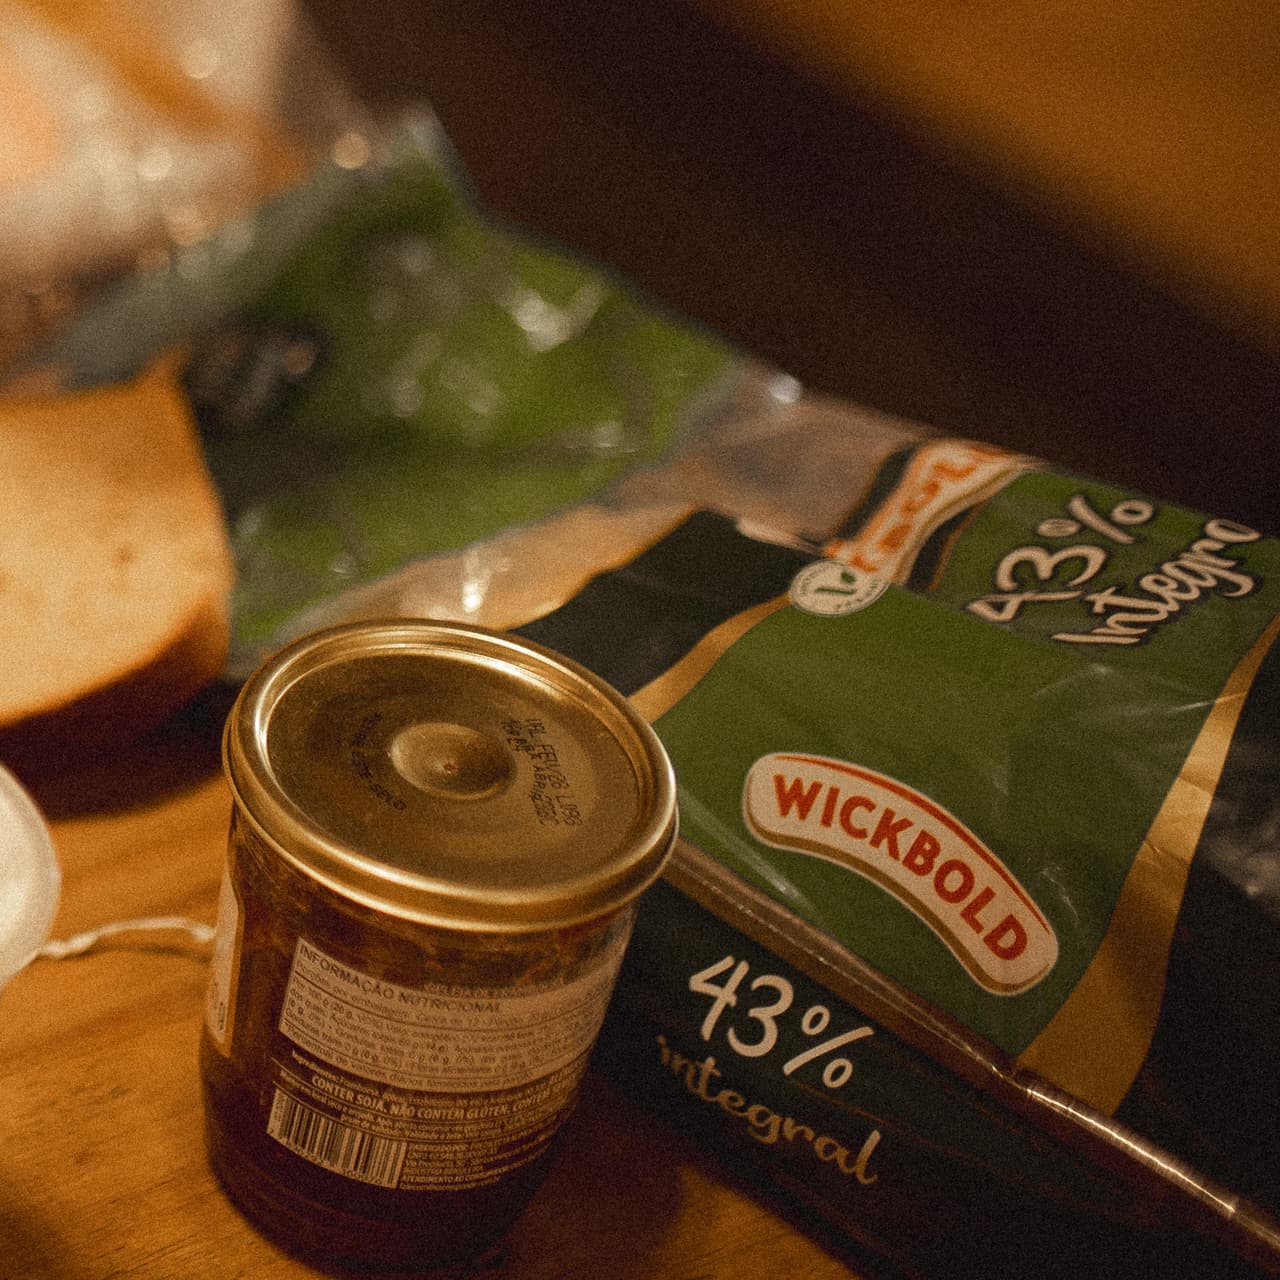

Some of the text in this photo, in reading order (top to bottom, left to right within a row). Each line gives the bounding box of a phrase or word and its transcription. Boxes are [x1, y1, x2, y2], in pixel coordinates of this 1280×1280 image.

[967, 494, 1154, 622] 43%
[772, 773, 1029, 962] WICKBOLD
[299, 942, 395, 1000] INFORMAÇÃO
[399, 991, 501, 1013] NUTRICIONAL
[688, 954, 876, 1090] 43%
